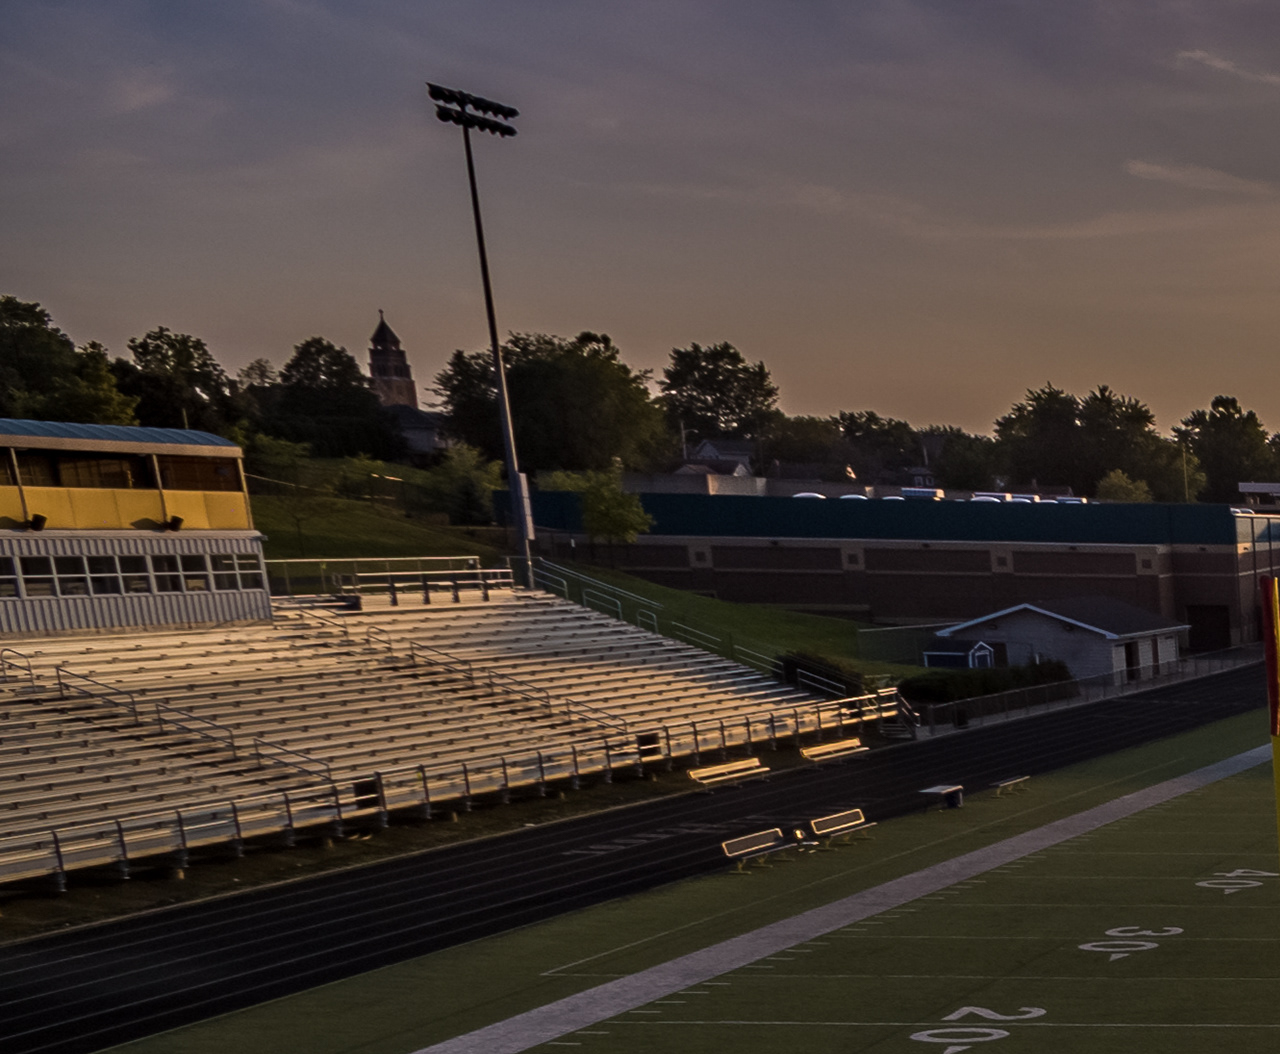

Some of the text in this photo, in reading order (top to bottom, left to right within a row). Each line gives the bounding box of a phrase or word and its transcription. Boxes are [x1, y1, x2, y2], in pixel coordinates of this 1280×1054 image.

[1195, 869, 1280, 888] 40
[1077, 926, 1184, 952] 30
[909, 1006, 1047, 1043] 20
